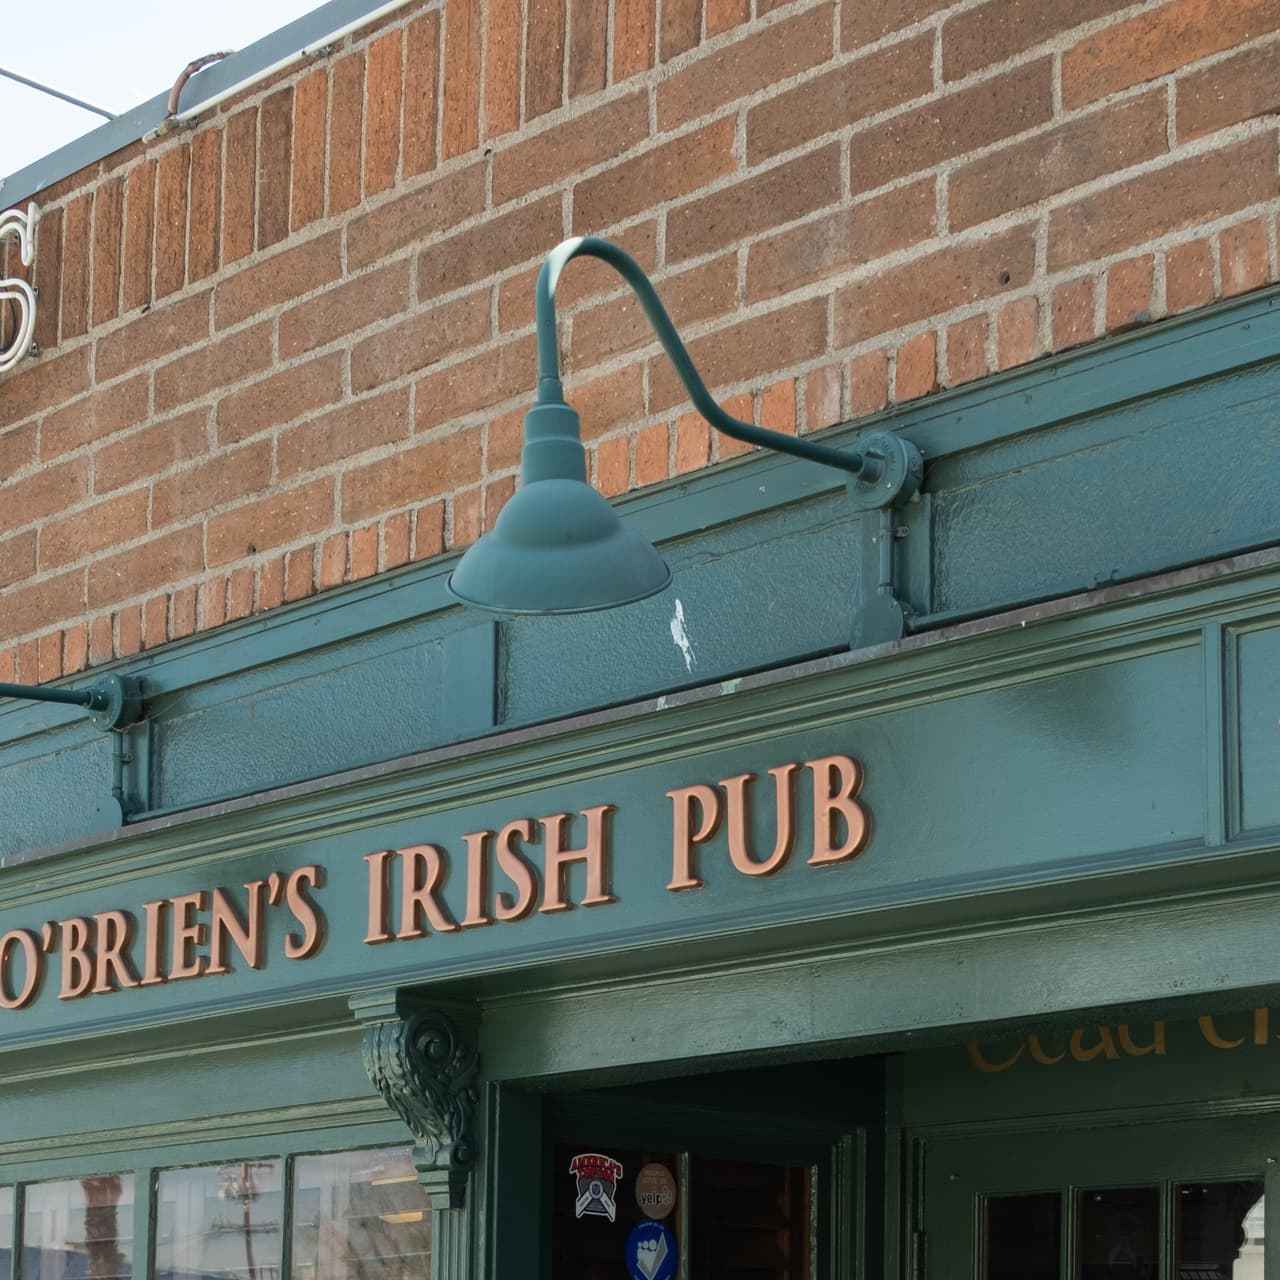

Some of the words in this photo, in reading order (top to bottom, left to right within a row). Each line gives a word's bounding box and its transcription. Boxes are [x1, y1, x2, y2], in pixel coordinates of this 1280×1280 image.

[363, 803, 617, 945] IRISH
[666, 753, 870, 893] PUB
[640, 1192, 664, 1206] yelp
